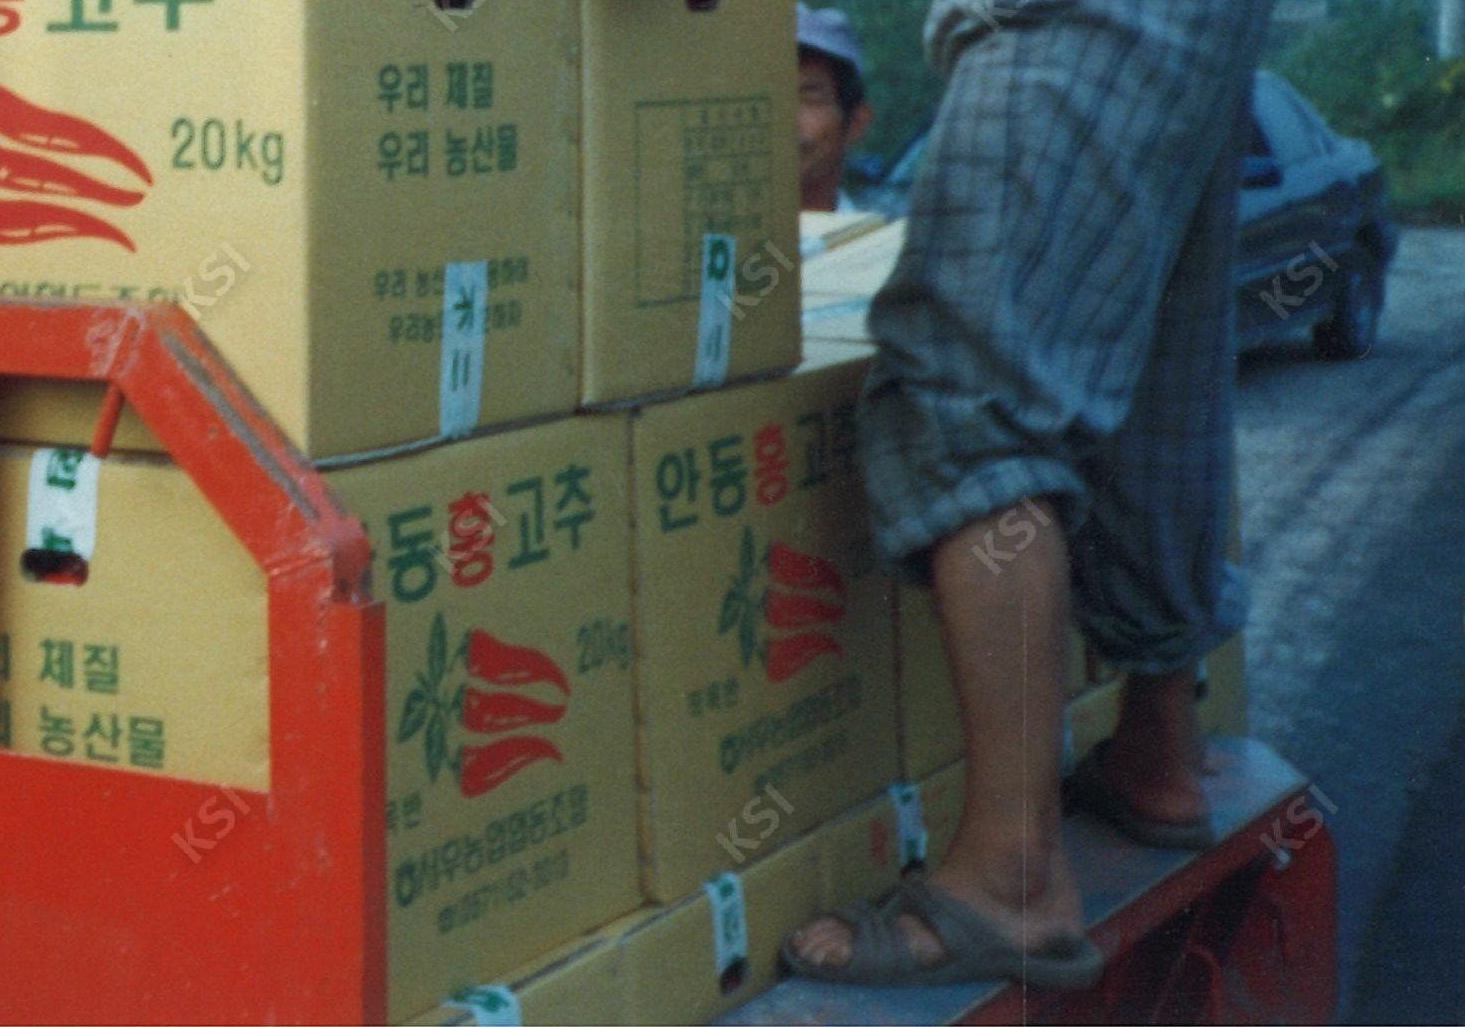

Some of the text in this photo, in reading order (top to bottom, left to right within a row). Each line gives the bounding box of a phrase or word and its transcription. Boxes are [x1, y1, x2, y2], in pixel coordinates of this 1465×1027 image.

[378, 62, 494, 112] 우리 체질
[170, 118, 285, 186] 20kg
[378, 124, 518, 180] 우리 농산물
[387, 464, 596, 603] 동홍고추
[39, 637, 120, 695] 체질
[39, 706, 166, 769] 농산물
